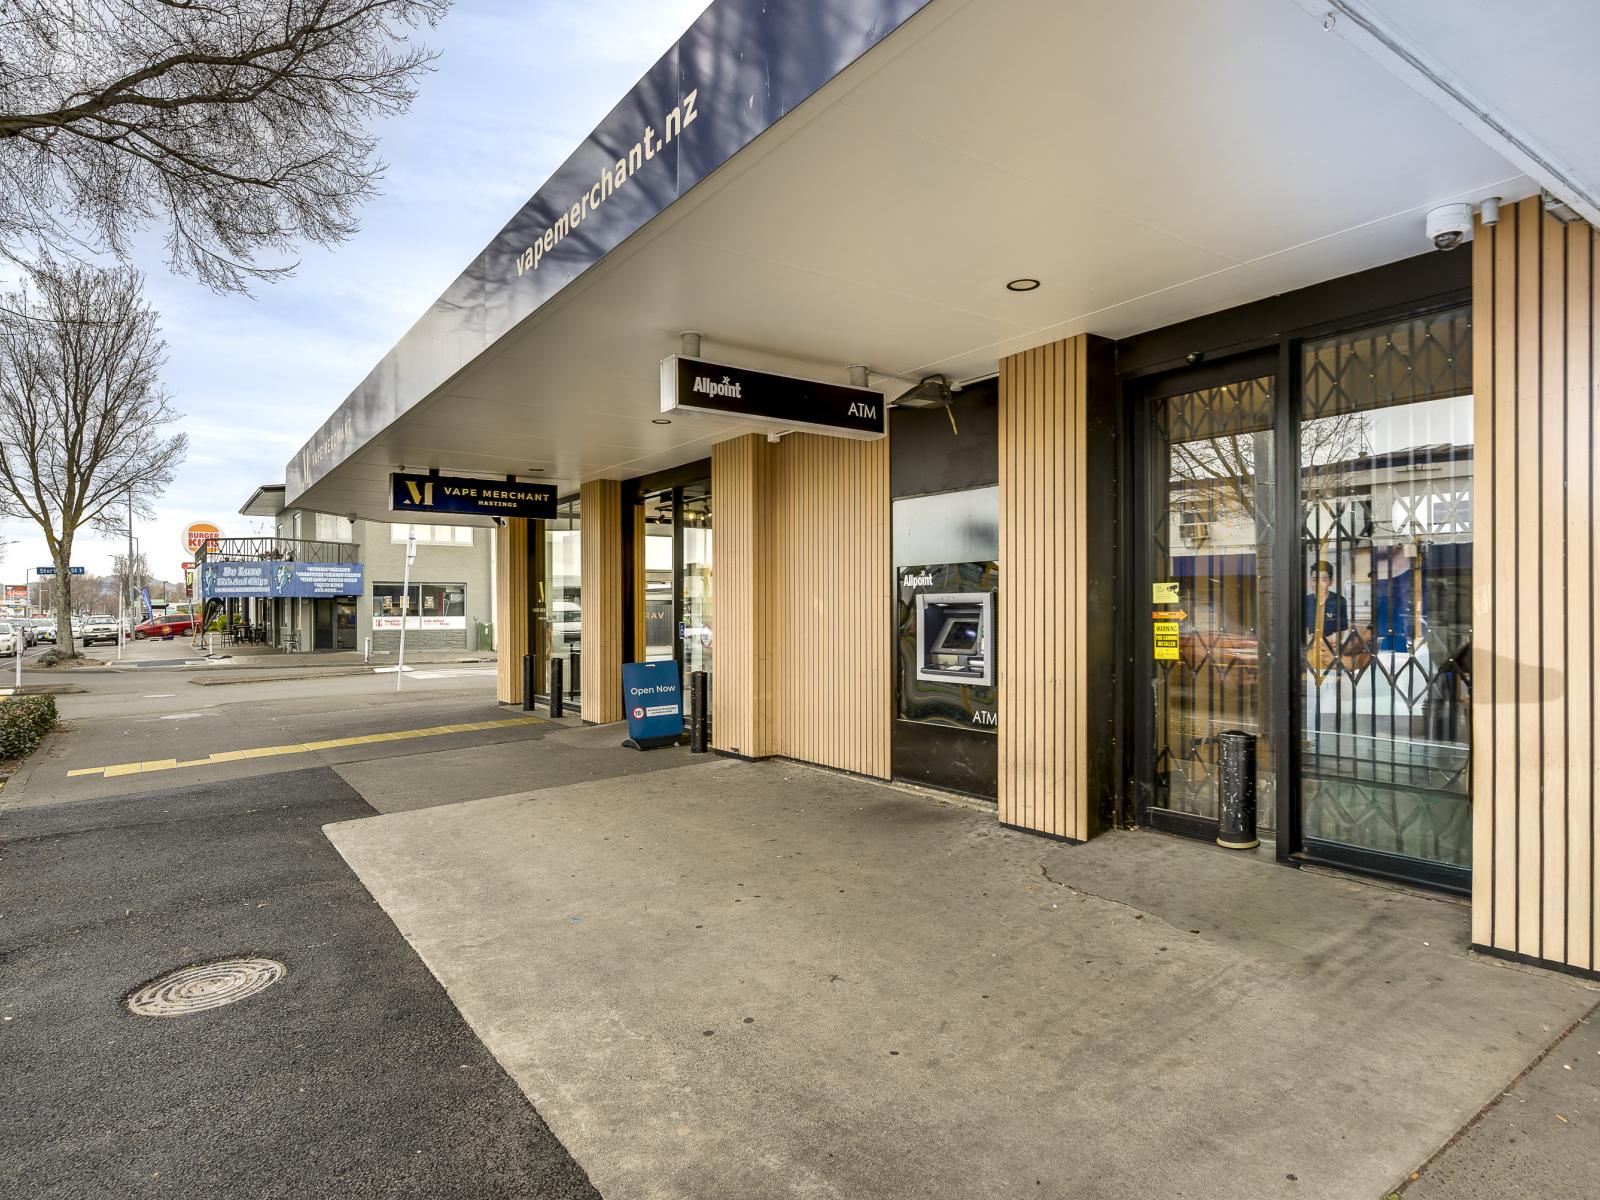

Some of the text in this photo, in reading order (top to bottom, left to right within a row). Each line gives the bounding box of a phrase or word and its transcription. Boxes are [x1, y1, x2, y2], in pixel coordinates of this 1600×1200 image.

[516, 88, 698, 277] vapemerchant.nz
[693, 376, 877, 420] Allpoint ATM
[443, 486, 550, 502] VAPE MERCHANT
[478, 500, 517, 508] HASTINGS
[903, 570, 933, 589] Allpoint
[1156, 625, 1177, 633] WARNING
[630, 685, 676, 696] Open Now
[972, 710, 998, 726] ATM
